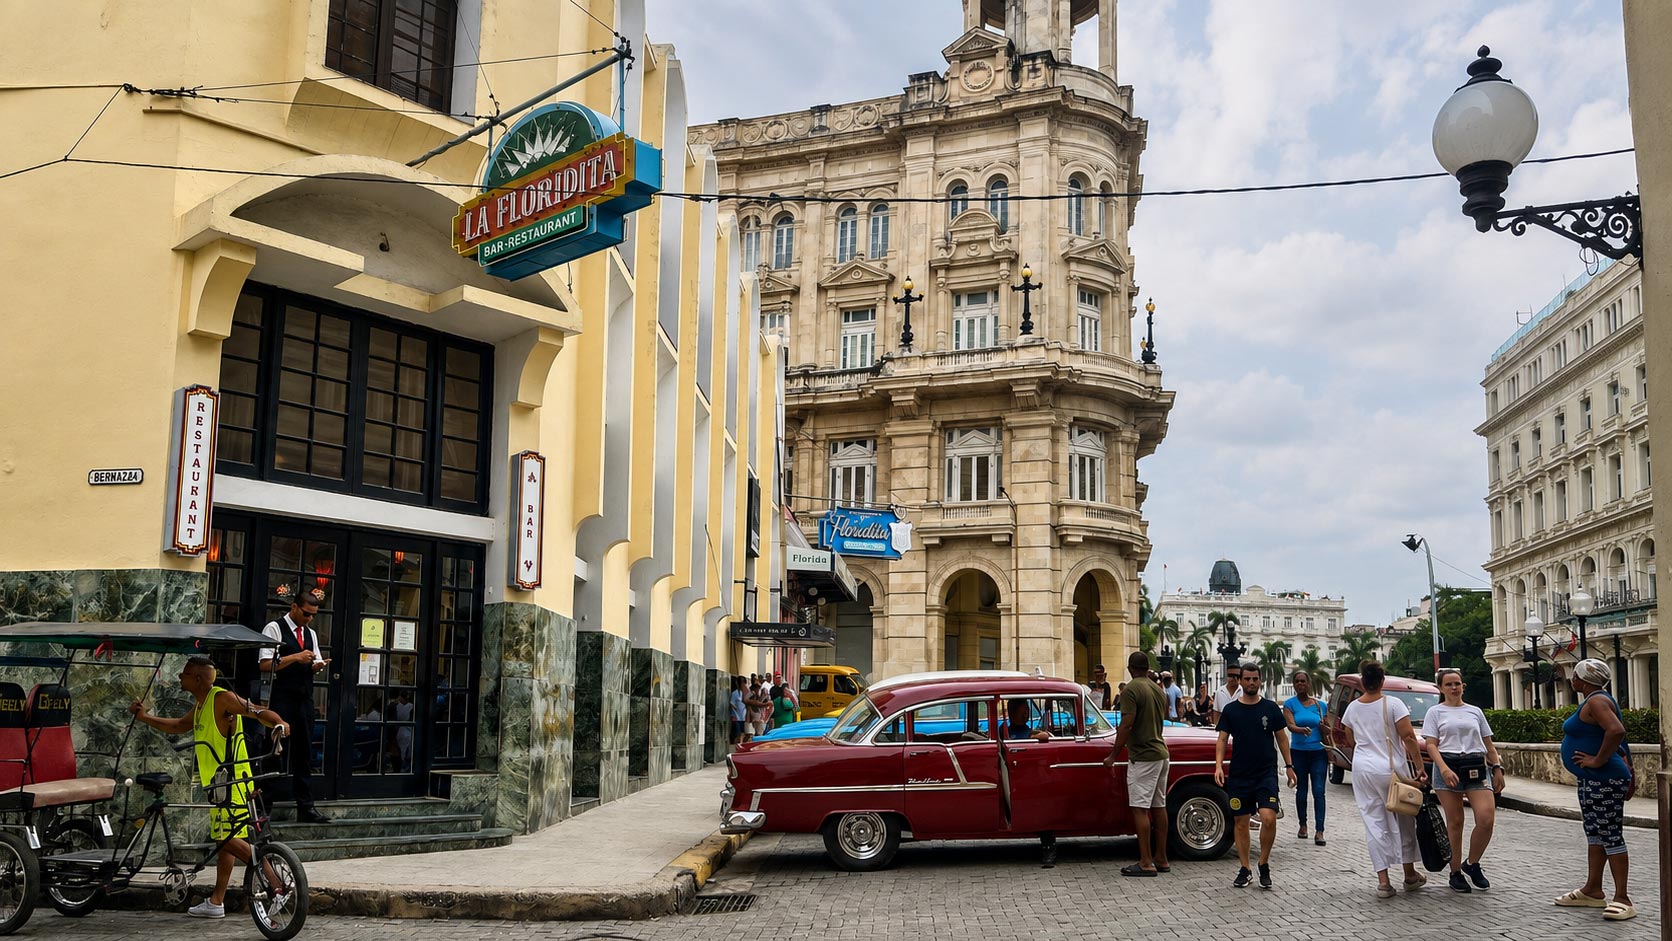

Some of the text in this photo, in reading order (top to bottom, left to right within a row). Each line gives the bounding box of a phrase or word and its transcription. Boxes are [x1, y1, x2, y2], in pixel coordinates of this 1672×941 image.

[464, 150, 617, 243] LA FLORIDITA
[187, 402, 205, 539] RESTAURANT
[526, 504, 534, 538] BAR
[0, 698, 26, 711] EELY
